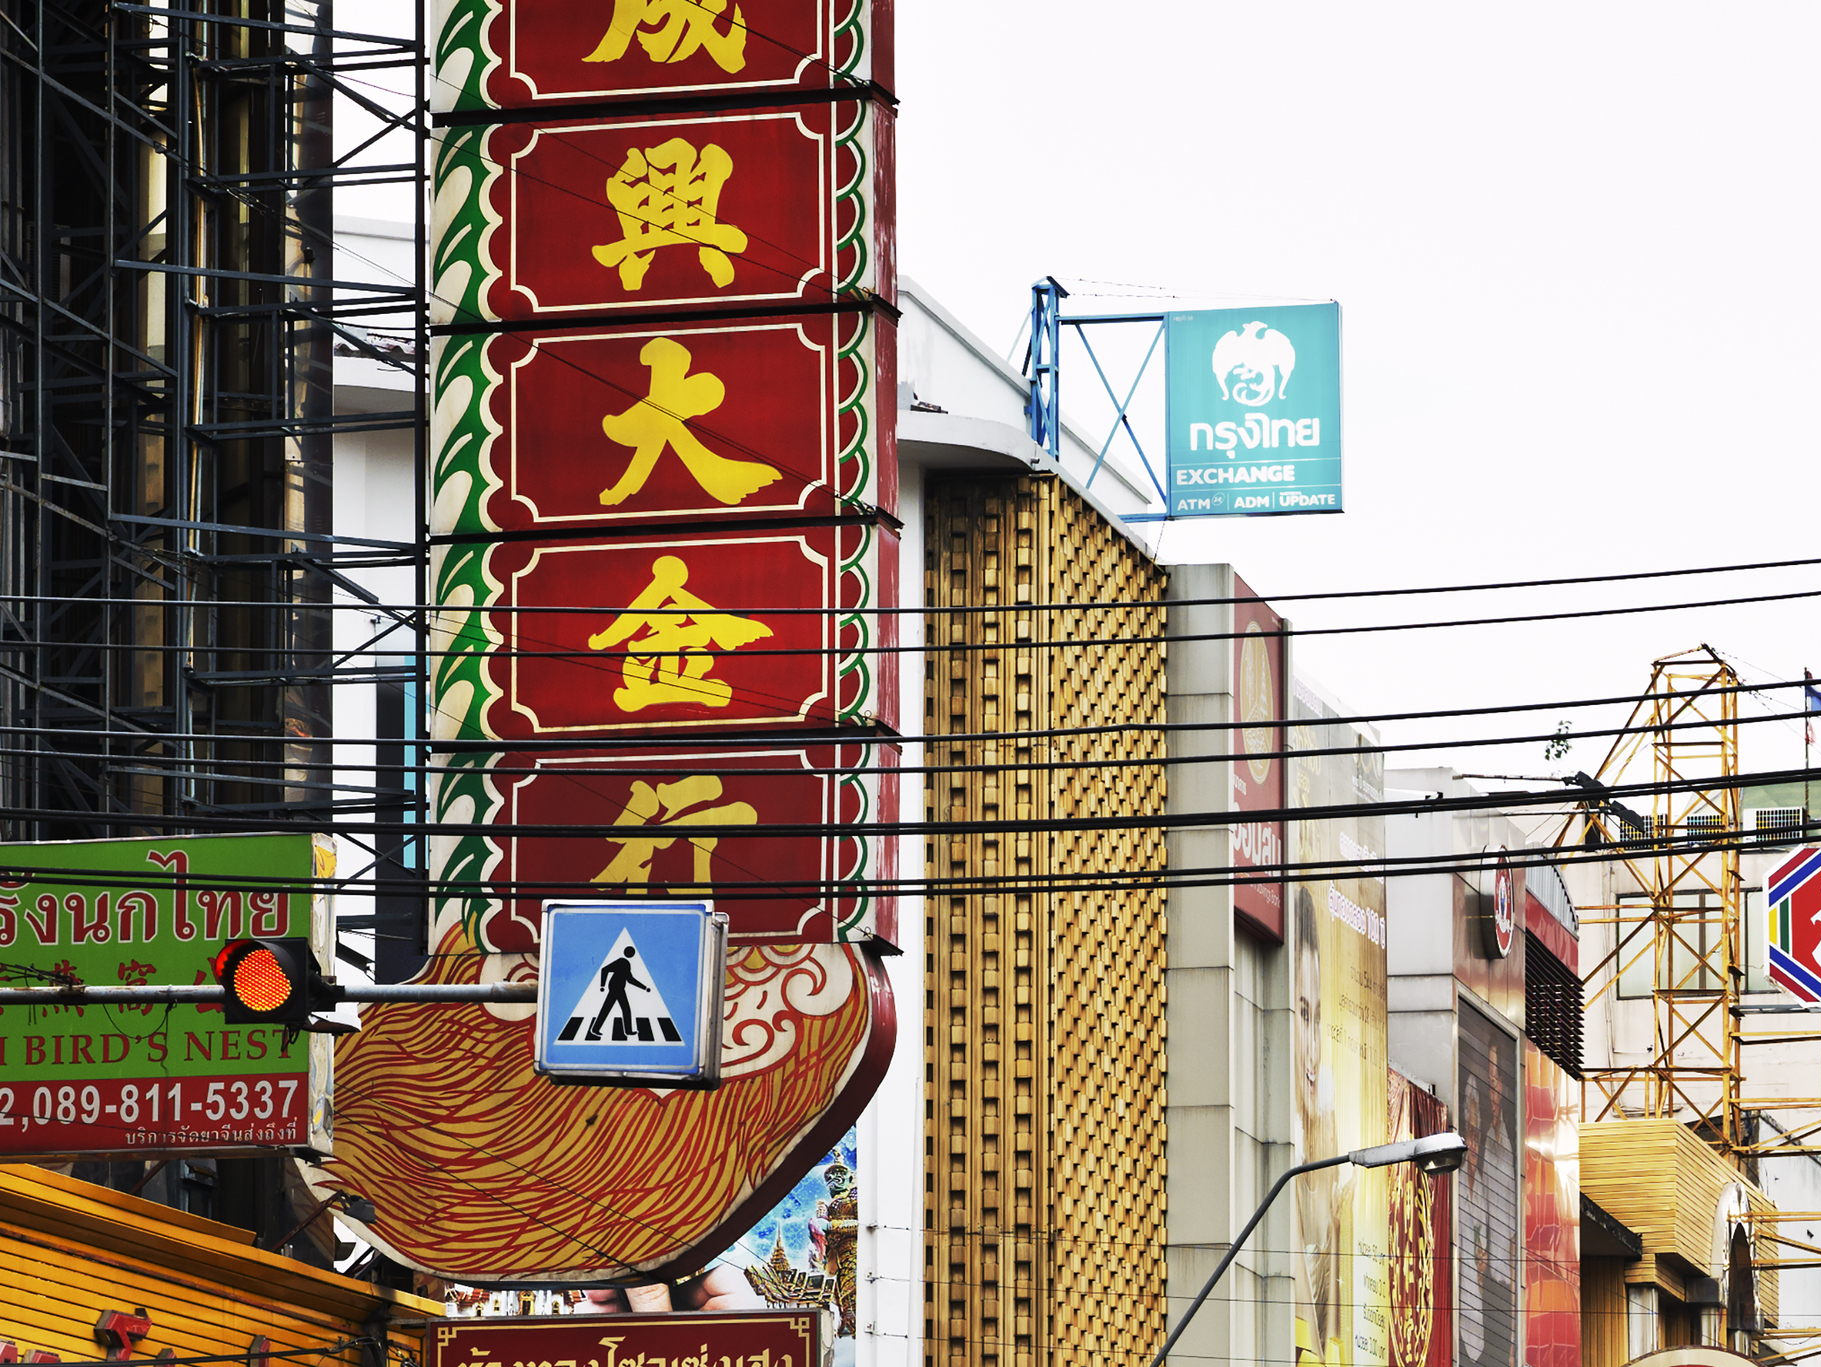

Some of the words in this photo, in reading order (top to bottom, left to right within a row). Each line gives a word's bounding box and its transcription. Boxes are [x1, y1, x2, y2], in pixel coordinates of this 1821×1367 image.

[1189, 413, 1321, 459] กรุงไทย
[1176, 465, 1296, 485] EXCHANGE
[1177, 498, 1211, 512] ATM
[1234, 496, 1269, 510] ADM
[1279, 494, 1336, 507] UPDATE
[24, 1032, 169, 1066] BIRD'S
[183, 1027, 294, 1063] NEST
